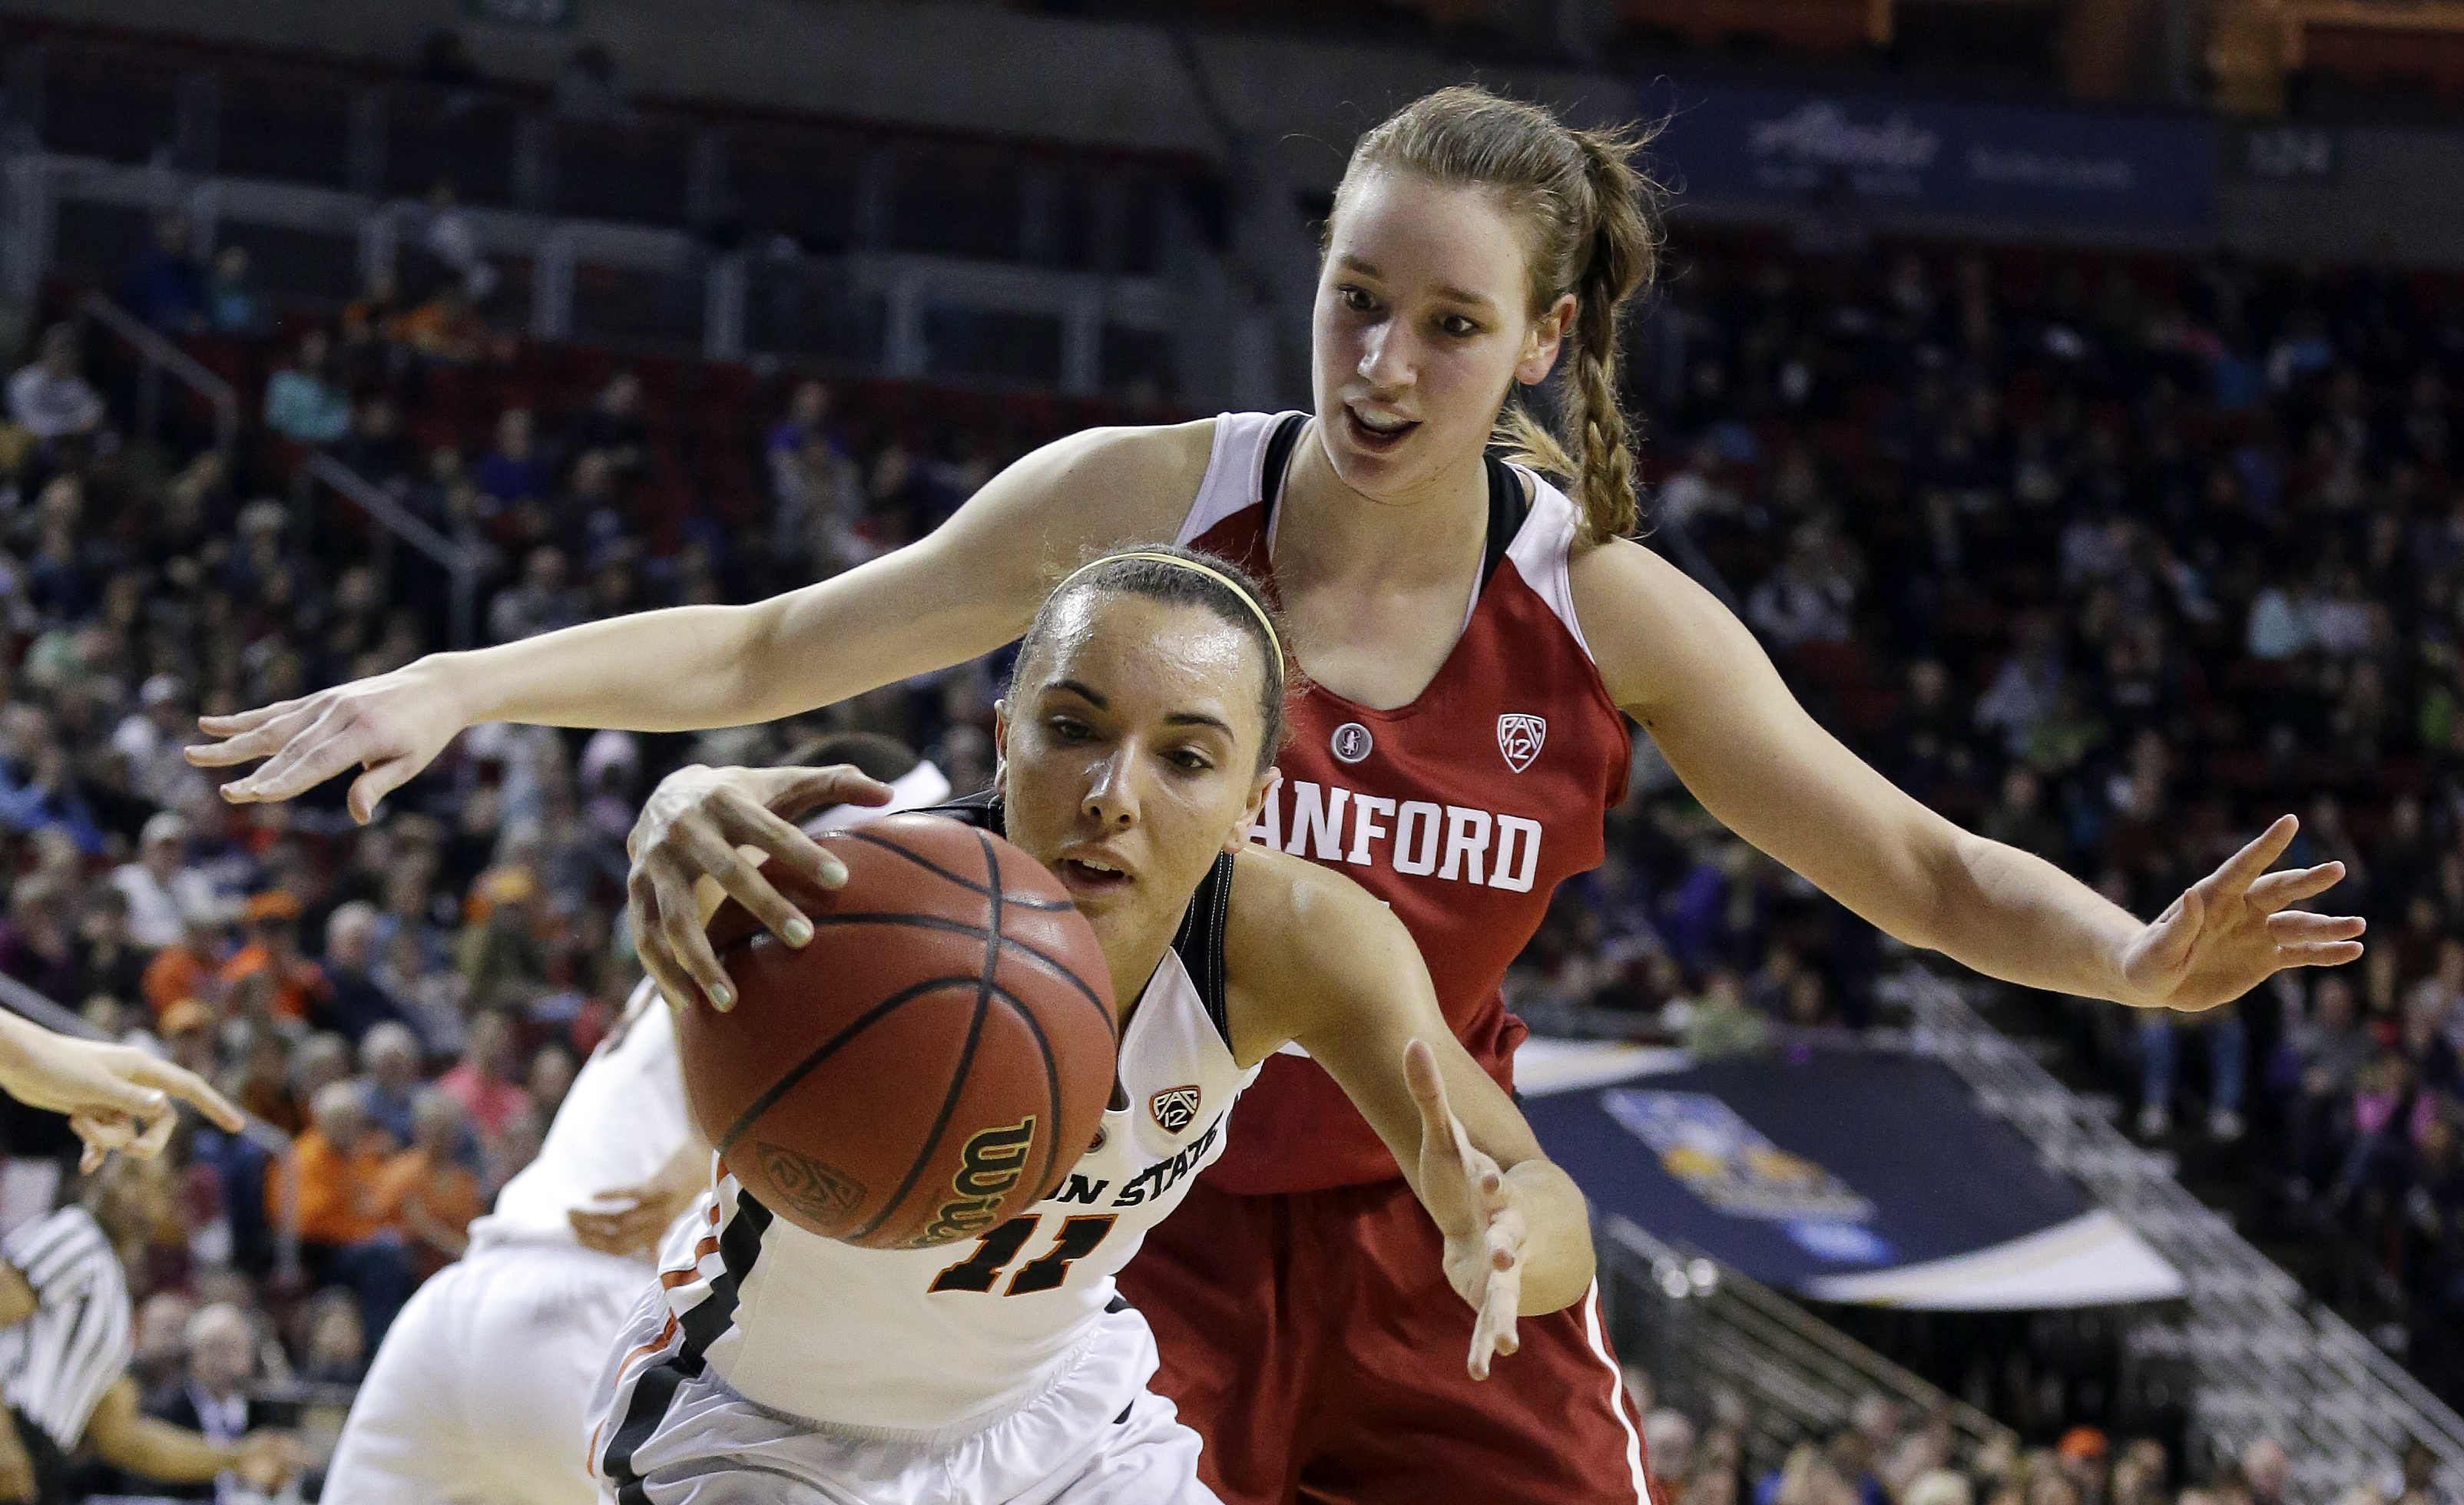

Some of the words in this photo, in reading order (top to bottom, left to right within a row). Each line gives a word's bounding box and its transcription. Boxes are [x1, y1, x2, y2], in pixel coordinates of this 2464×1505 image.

[1501, 716, 1542, 750] PAC
[1509, 738, 1531, 759] 12
[1153, 1090, 1198, 1121] PAC
[1164, 1109, 1188, 1128] 12
[927, 1214, 1118, 1296] 11
